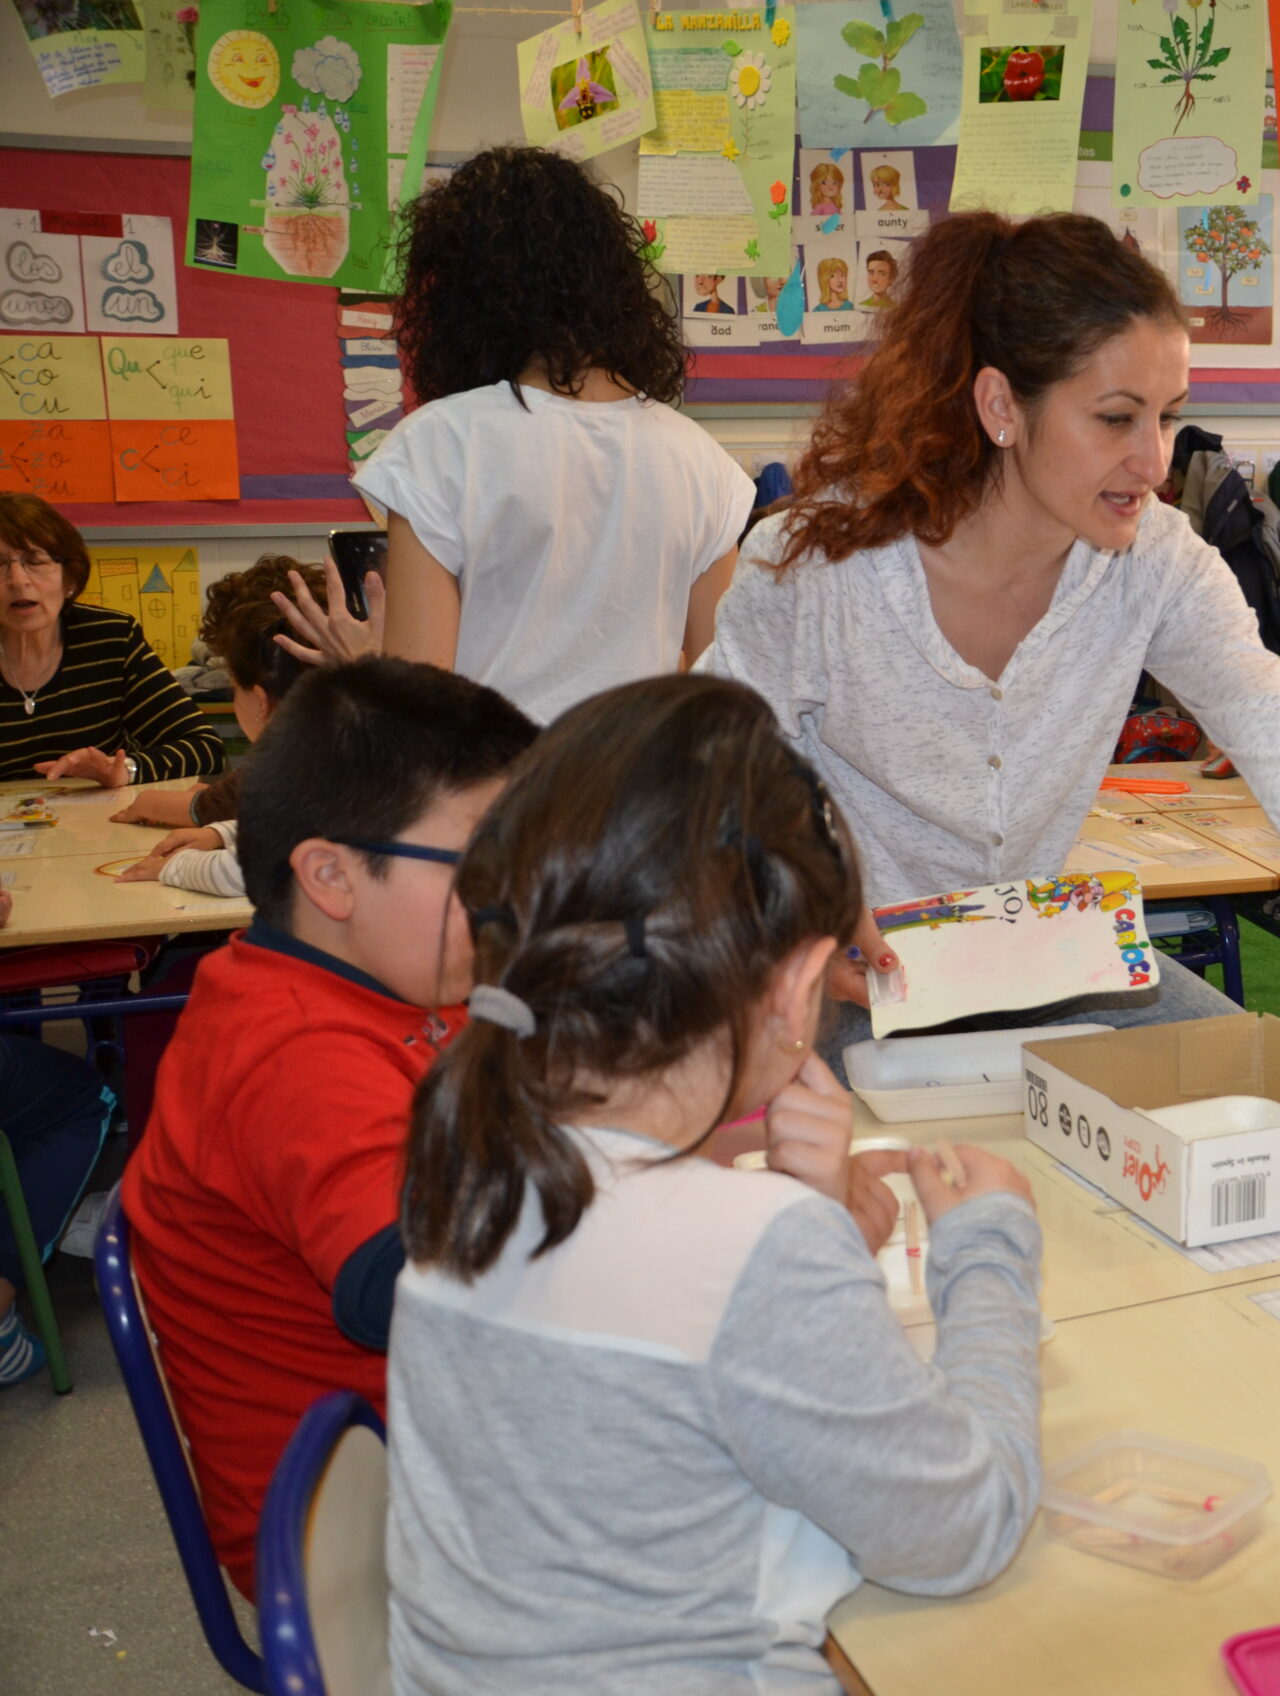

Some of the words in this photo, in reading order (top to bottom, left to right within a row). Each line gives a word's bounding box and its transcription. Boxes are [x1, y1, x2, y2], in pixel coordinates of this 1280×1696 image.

[656, 15, 673, 31] LA
[877, 214, 909, 230] aunty
[111, 244, 142, 277] el
[108, 294, 157, 315] un
[710, 325, 732, 337] dad
[823, 323, 851, 333] mum
[18, 342, 62, 361] ca
[162, 345, 206, 373] que
[18, 368, 59, 386] co
[168, 378, 212, 413] qui
[28, 422, 73, 440] za
[1113, 908, 1152, 988] CARIOCA
[1211, 1159, 1236, 1169] Spain
[1249, 1153, 1271, 1164] Made
